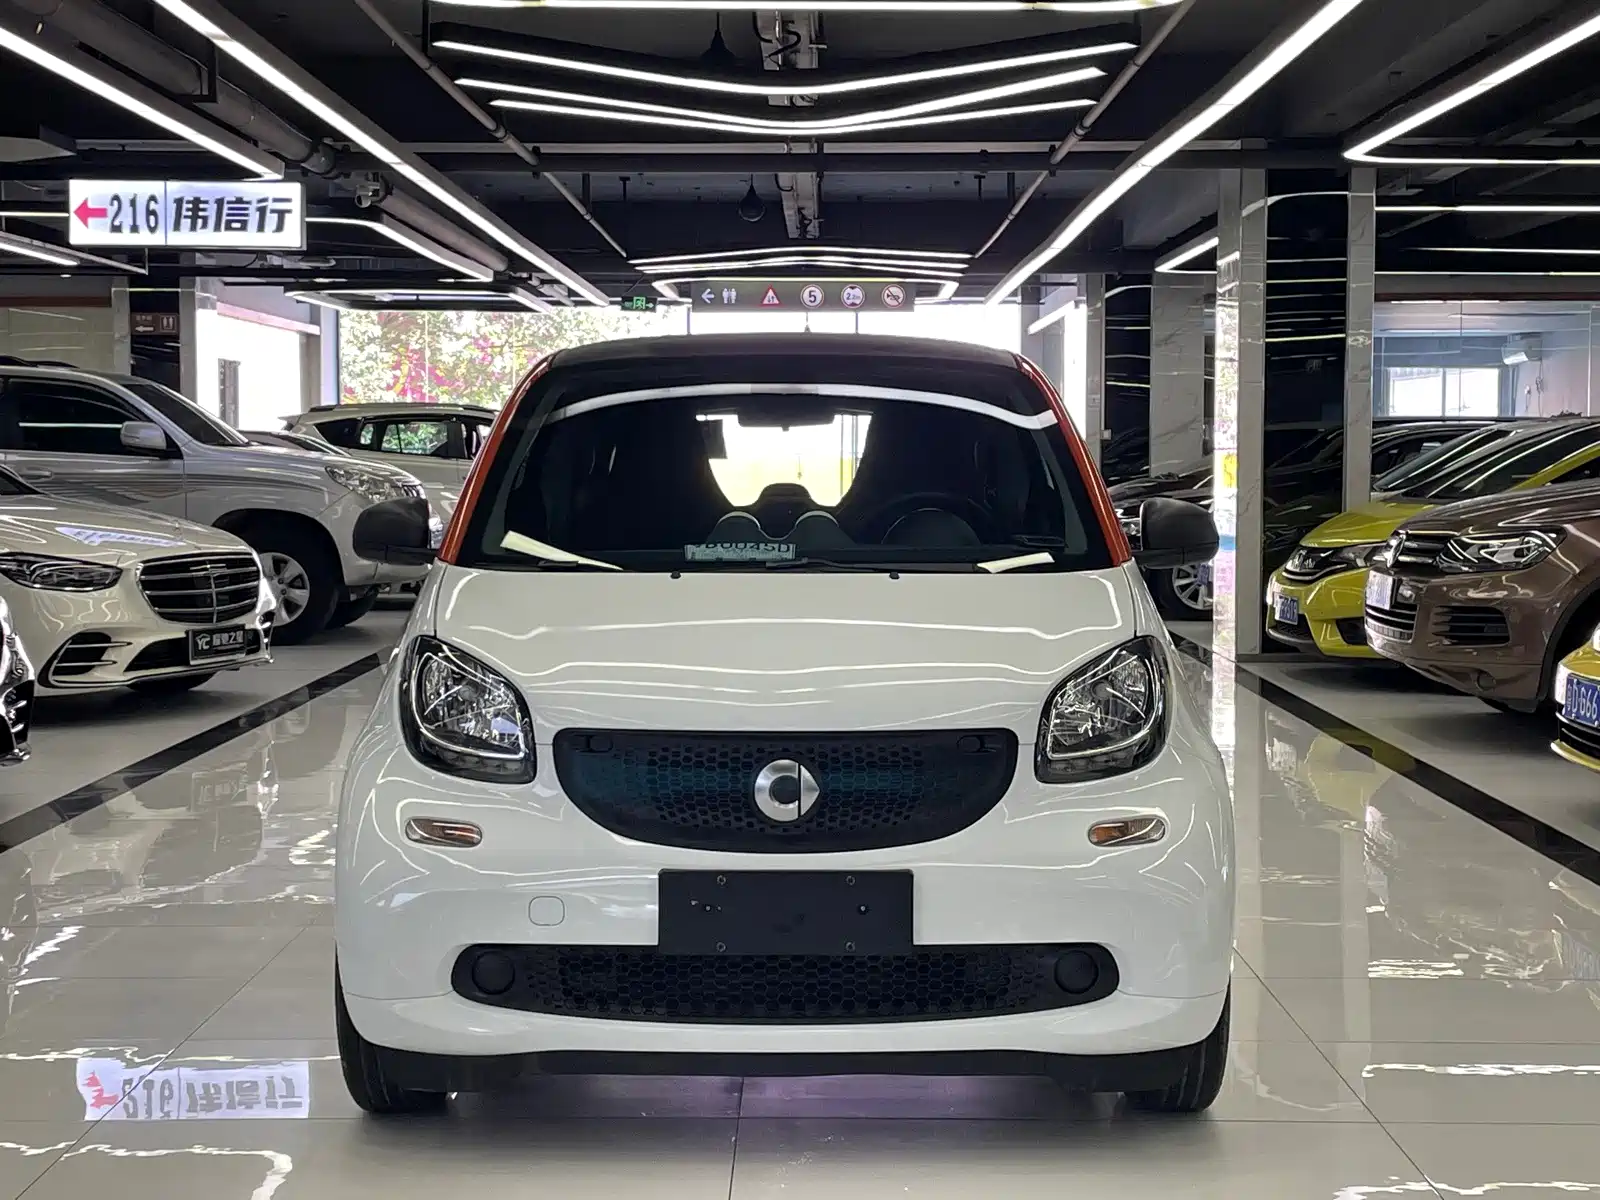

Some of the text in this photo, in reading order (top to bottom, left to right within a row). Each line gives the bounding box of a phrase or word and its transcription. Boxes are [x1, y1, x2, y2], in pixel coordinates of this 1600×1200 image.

[109, 193, 293, 234] 216 伟信行
[808, 290, 817, 303] 5
